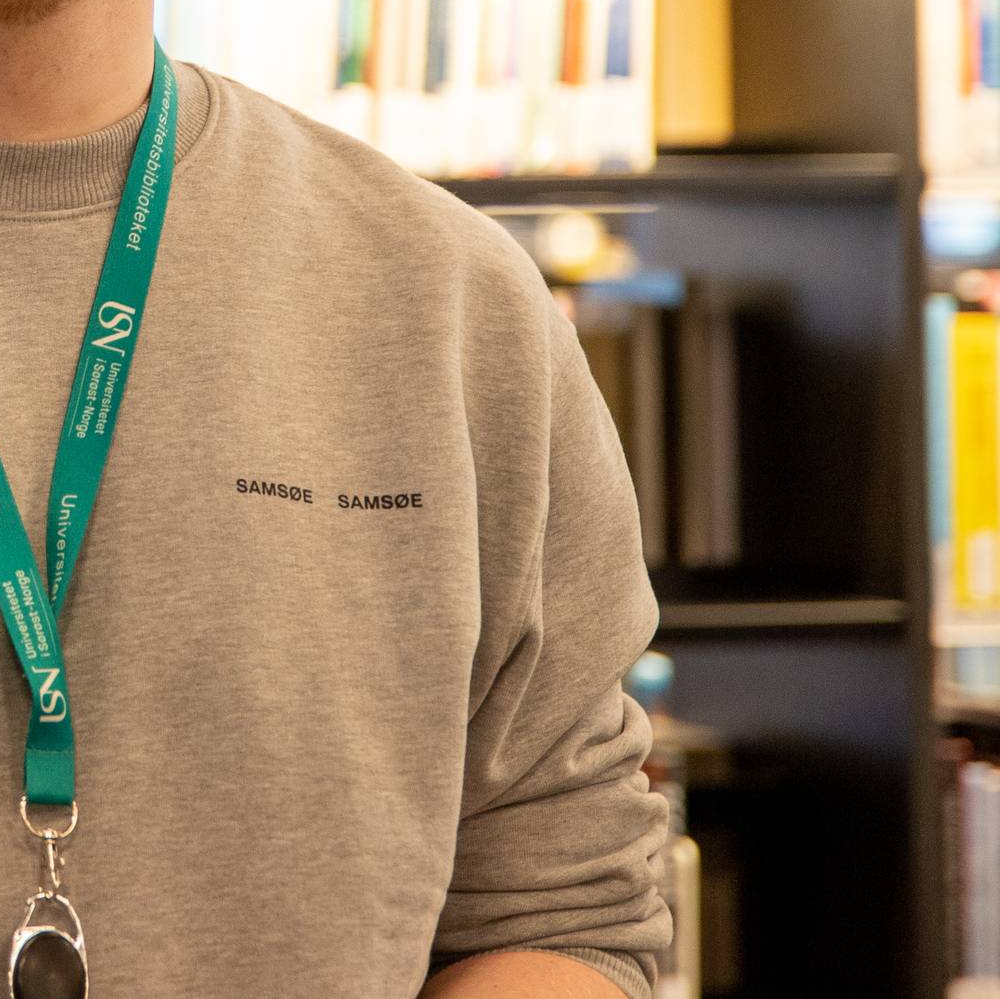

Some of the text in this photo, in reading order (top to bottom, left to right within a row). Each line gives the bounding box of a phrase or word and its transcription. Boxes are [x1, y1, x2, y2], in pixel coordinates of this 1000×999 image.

[127, 64, 175, 252] Universitetsbiblioteket
[94, 361, 122, 435] Universitetet
[236, 478, 424, 510] SAMSØE SAMSØE
[2, 580, 37, 659] Universitetet
